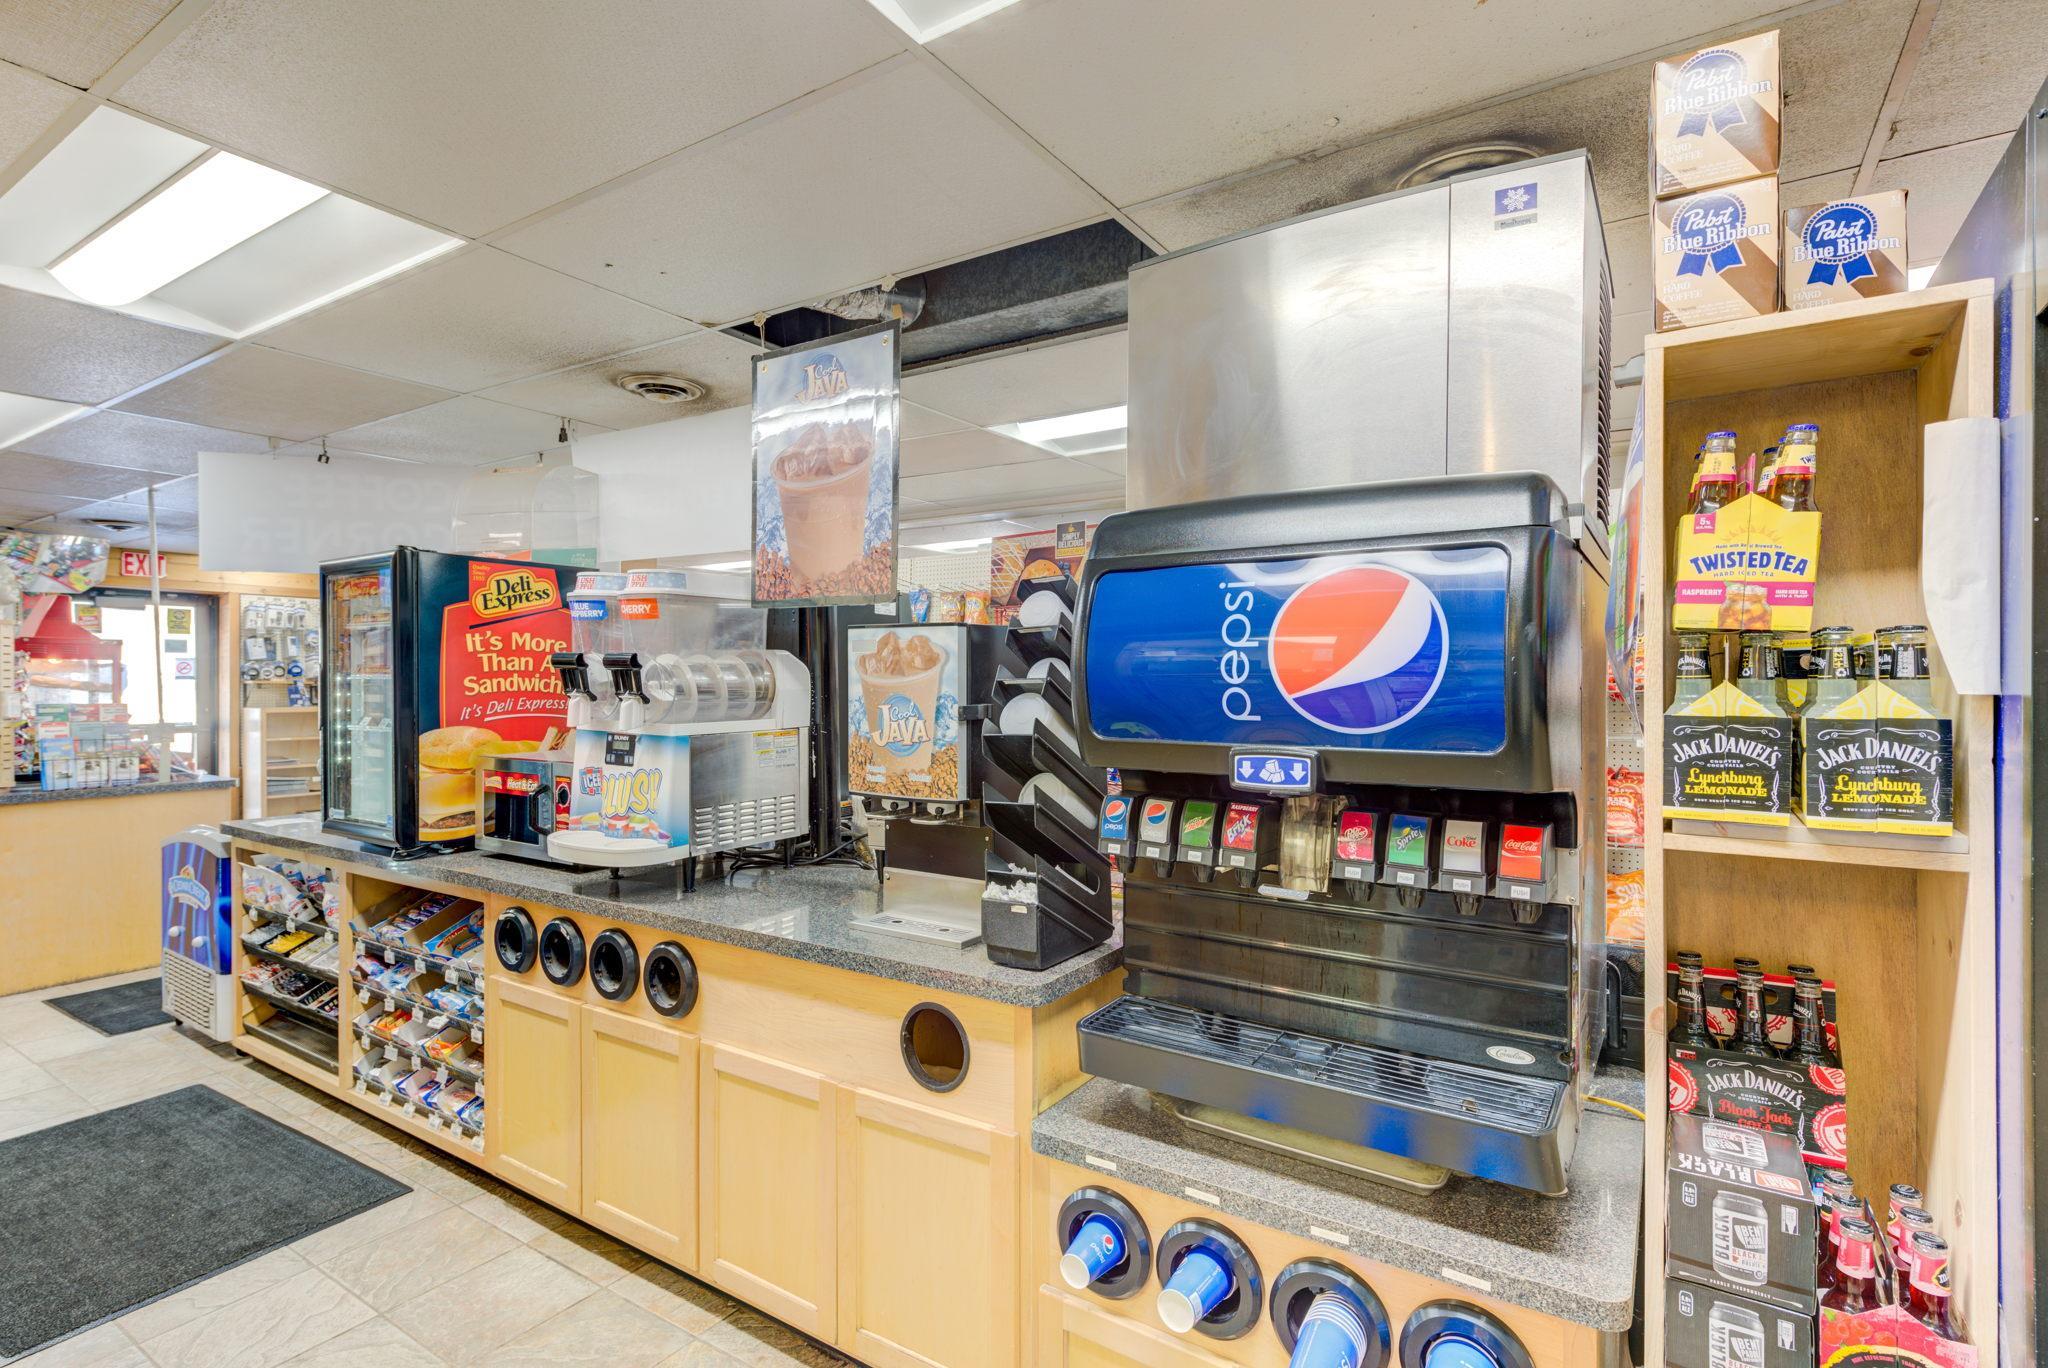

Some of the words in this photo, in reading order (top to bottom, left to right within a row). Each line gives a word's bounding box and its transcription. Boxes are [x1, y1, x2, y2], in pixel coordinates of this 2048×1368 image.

[1685, 65, 1735, 92] Pabst
[1664, 96, 1706, 115] Blue
[1706, 79, 1772, 104] Ribbon
[1684, 206, 1735, 233] Pabst
[1815, 218, 1866, 242] Pabst
[1663, 233, 1703, 254] Blue
[1705, 222, 1771, 246] Ribbon
[1792, 244, 1835, 263] Blue
[1836, 234, 1900, 256] Ribbon
[1793, 289, 1822, 300] HARD
[795, 363, 849, 405] JAVA
[1690, 551, 1772, 575] TWISTED
[1774, 551, 1808, 576] TEA
[494, 575, 531, 596] Deli
[1681, 588, 1722, 596] RASPBERRY
[481, 588, 550, 611] Express
[621, 604, 651, 614] CHERRY
[465, 632, 503, 653] It's
[511, 632, 568, 653] More
[1219, 581, 1261, 722] pepsi
[478, 653, 534, 673] Than
[540, 655, 556, 675] A
[460, 703, 482, 721] It's
[486, 698, 513, 715] Deli
[517, 697, 568, 711] Express!
[891, 702, 918, 721] Cool
[871, 704, 931, 747] JAVA
[1672, 736, 1715, 763] JACK
[1714, 732, 1783, 769] DANIEL'S
[1815, 742, 1863, 770] JACK
[1865, 737, 1942, 775] DANIEL'S
[1687, 767, 1765, 789] Lynchburg
[1834, 774, 1923, 798] Lynchburg
[1684, 784, 1768, 797] LEMONADE
[1832, 793, 1927, 805] LEMONADE
[1231, 804, 1259, 812] RASPBERRY
[1104, 822, 1123, 831] pepsi
[1396, 829, 1419, 850] Sprite
[1446, 836, 1477, 848] Coke
[1505, 839, 1538, 851] Coca-Cola
[1705, 1073, 1744, 1093] JACK
[1744, 1069, 1806, 1110] DANIEL'S
[1719, 1098, 1758, 1118] Black
[1758, 1106, 1793, 1126] Jack
[1678, 1158, 1752, 1184] BLACK
[1715, 1213, 1730, 1260] BLACK
[1090, 1243, 1106, 1264] pepsi
[1711, 1325, 1726, 1368] BLACK
